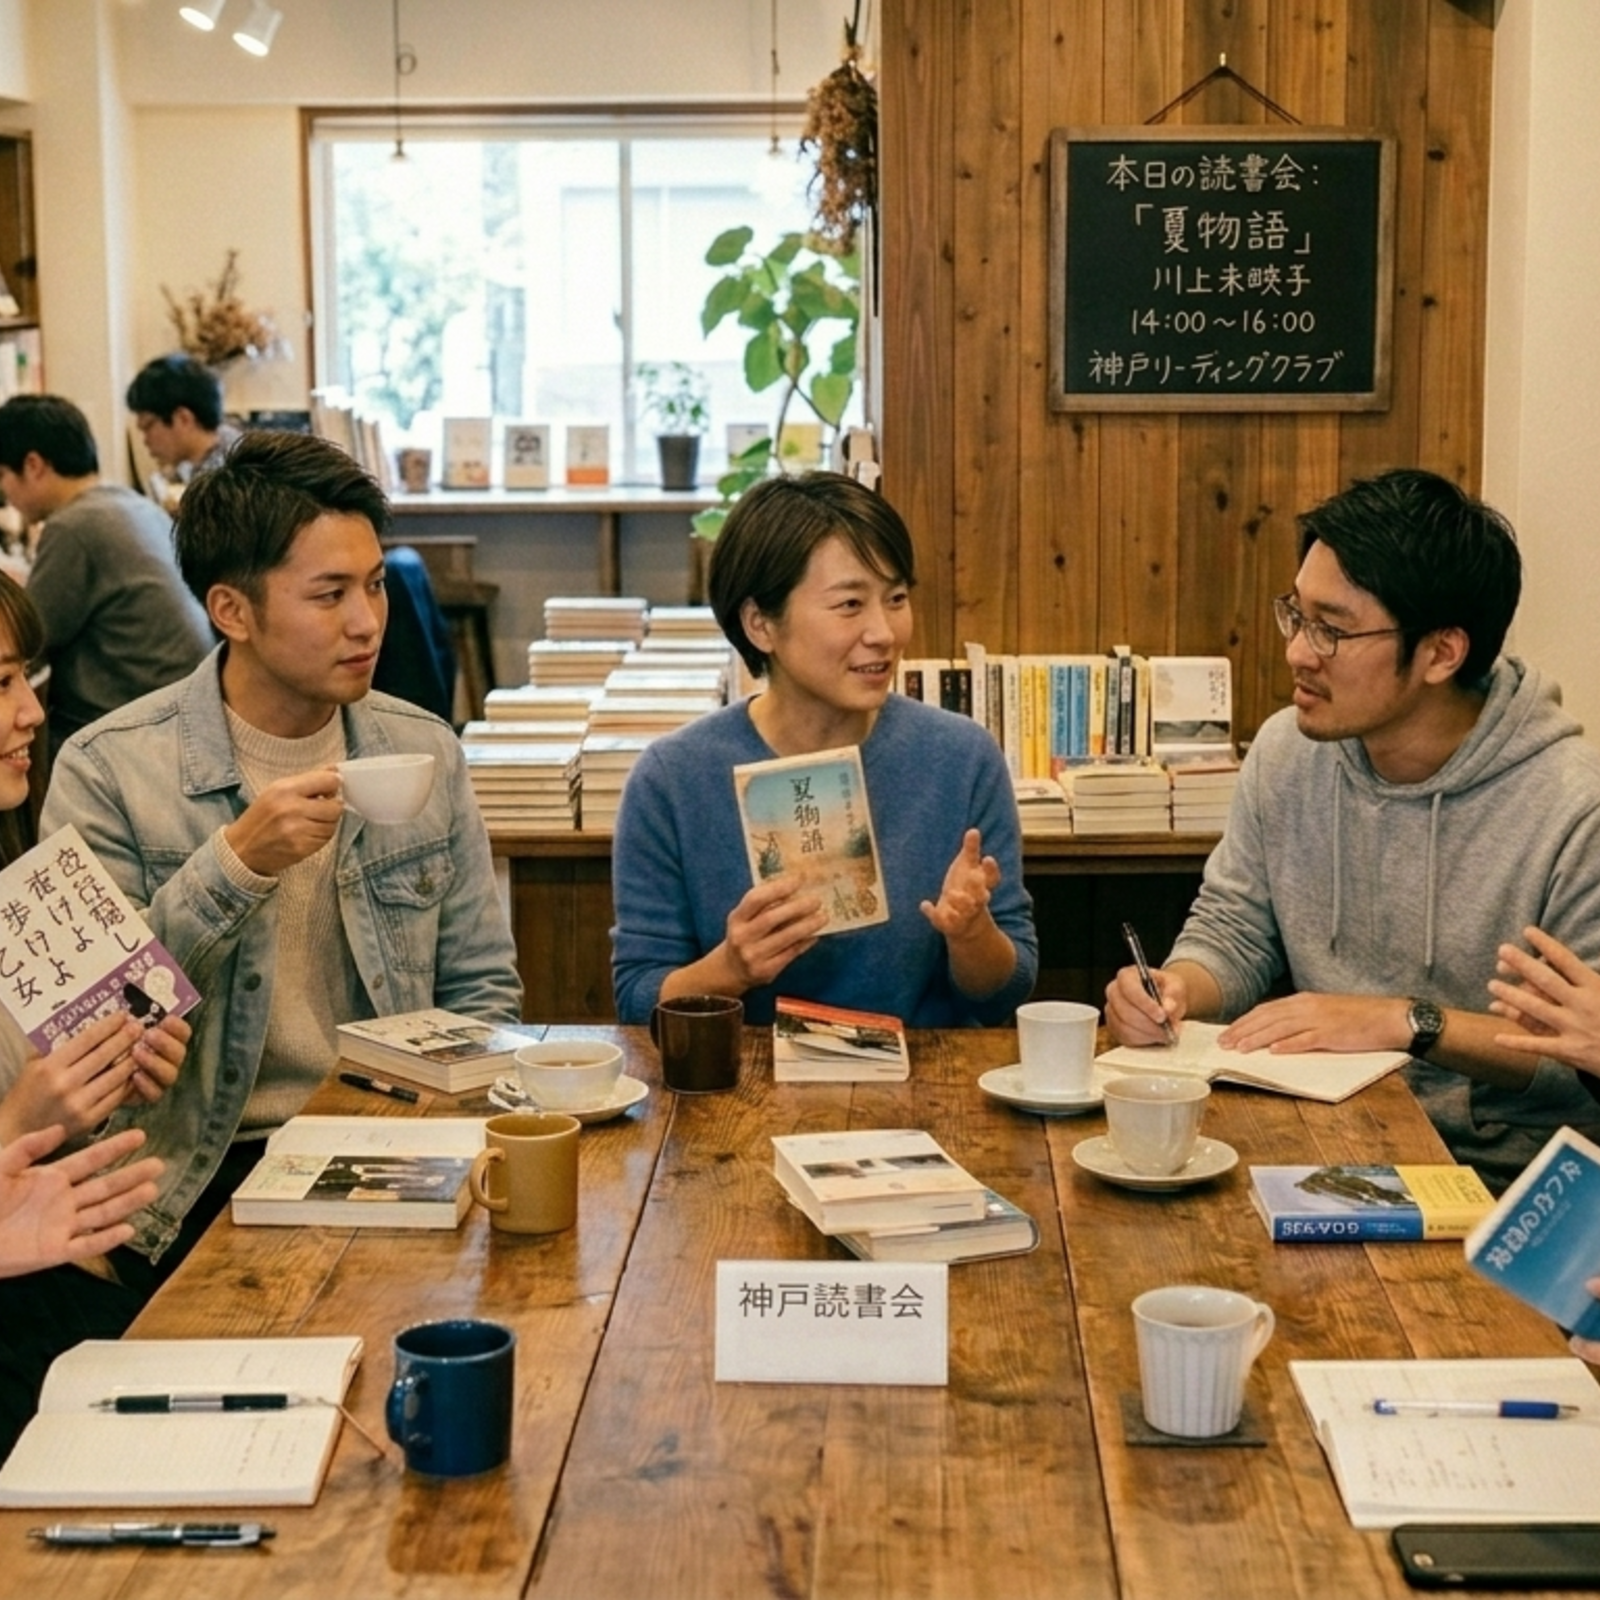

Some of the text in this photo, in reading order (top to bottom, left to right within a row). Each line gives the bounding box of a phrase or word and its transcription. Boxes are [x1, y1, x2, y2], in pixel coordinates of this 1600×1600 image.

[1106, 153, 1320, 192] 本日の読書会：
[1134, 203, 1312, 255] 「夏物語」
[1088, 350, 1345, 387] 神戸リーディングクラブ
[738, 1281, 925, 1320] 神戸読書会
